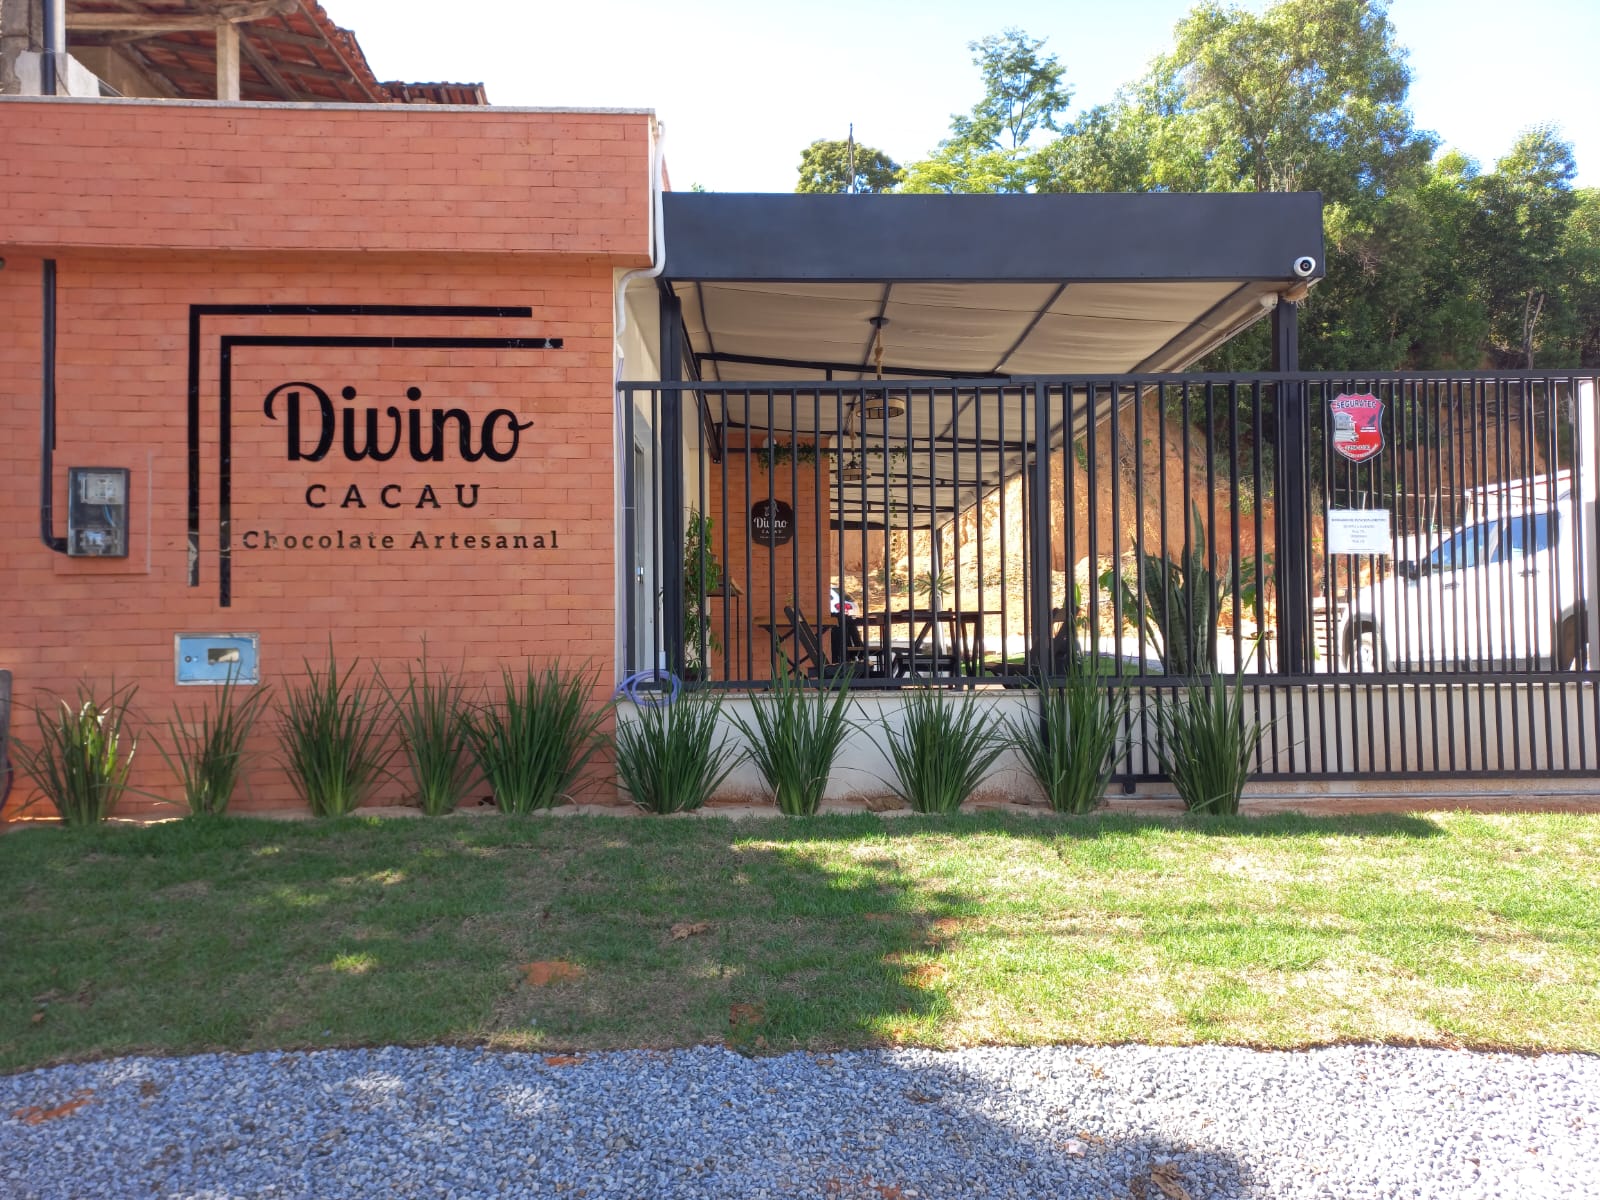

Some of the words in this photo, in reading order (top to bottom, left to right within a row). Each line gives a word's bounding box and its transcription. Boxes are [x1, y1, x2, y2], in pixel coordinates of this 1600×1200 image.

[263, 381, 534, 462] Divino
[305, 484, 481, 509] CACAU
[753, 517, 788, 528] Dino
[242, 530, 395, 550] Chocolate
[409, 530, 560, 549] Artesanal
